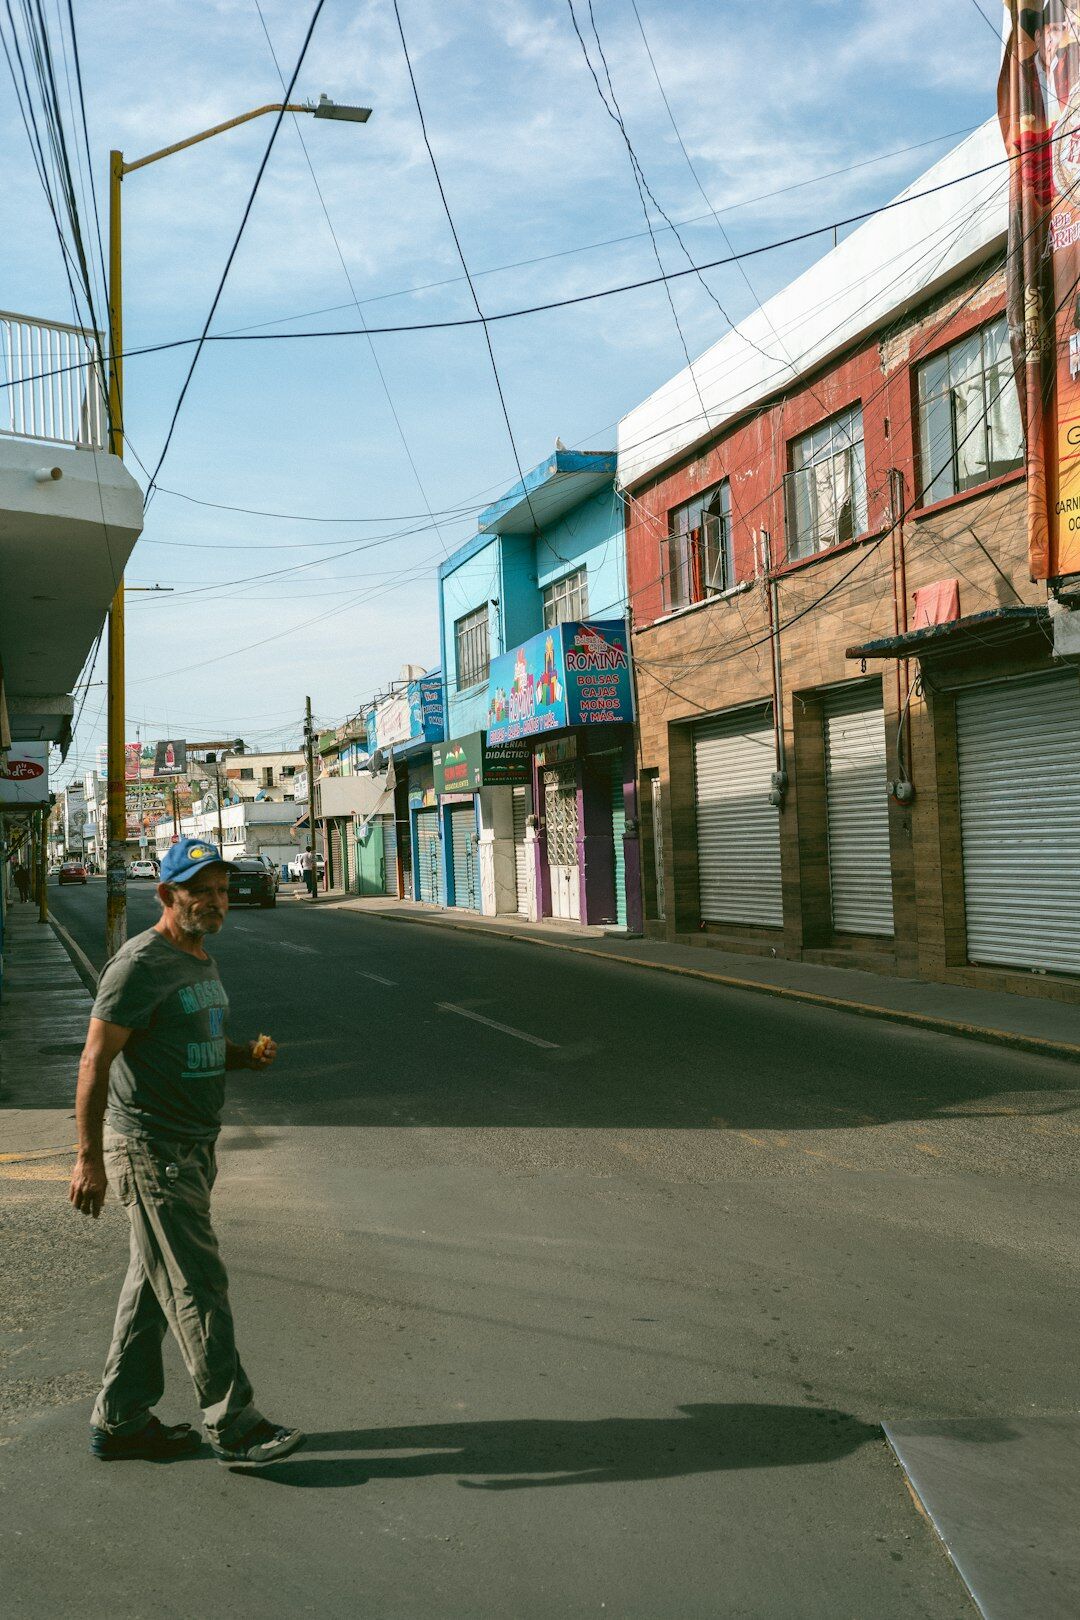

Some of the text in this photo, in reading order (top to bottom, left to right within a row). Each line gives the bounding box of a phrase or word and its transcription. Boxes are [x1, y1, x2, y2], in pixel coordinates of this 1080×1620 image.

[566, 651, 628, 671] ROMINA
[577, 674, 620, 685] BOLSAS
[582, 687, 617, 698] CAJAS
[581, 697, 621, 710] MOÑOS
[580, 712, 588, 722] Y
[485, 749, 530, 760] DIDÁCTICO
